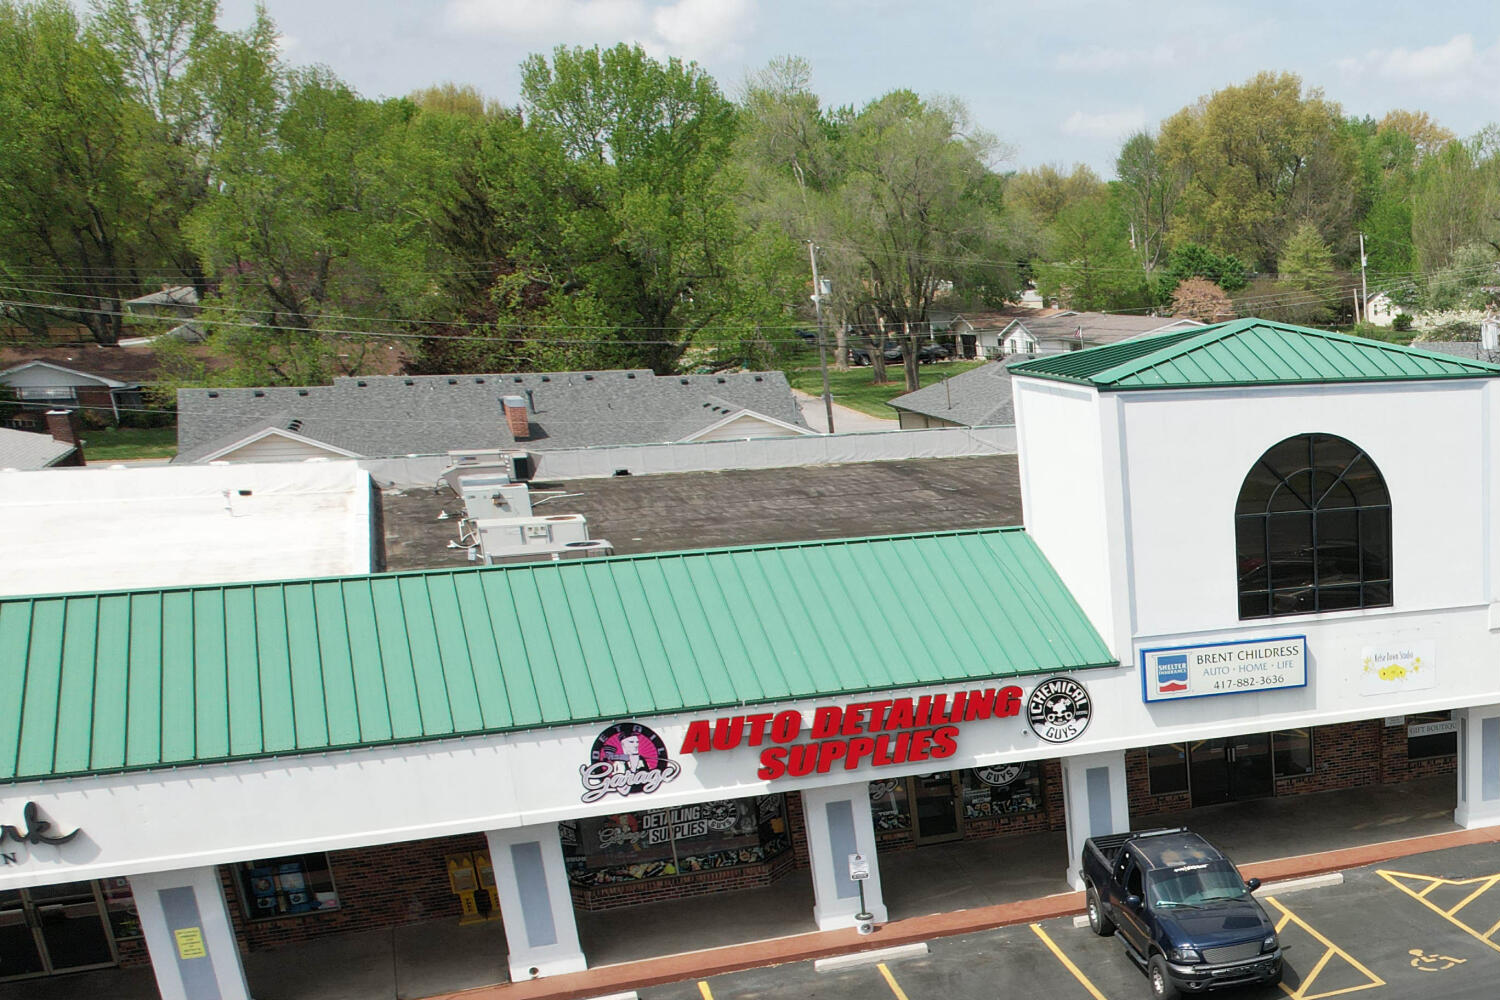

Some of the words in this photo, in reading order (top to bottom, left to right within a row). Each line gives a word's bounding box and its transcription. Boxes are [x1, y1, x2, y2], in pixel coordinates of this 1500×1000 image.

[1197, 653, 1233, 665] BRENT
[1237, 645, 1299, 661] CHILDRESS
[1158, 662, 1187, 671] SHELTER
[1203, 666, 1230, 677] AUTO
[1238, 662, 1268, 673] HOME
[1277, 659, 1294, 669] LIFE
[1214, 675, 1285, 690] 417-882-3636
[1030, 681, 1089, 714] CHEMICAL
[680, 709, 803, 755] AUTO
[811, 685, 1024, 740] DETAILING
[1046, 724, 1078, 740] GUYS
[757, 725, 961, 781] SUPPLIES
[579, 760, 682, 804] Garage
[985, 769, 1014, 783] GUYS
[651, 820, 706, 843] SUPLIES
